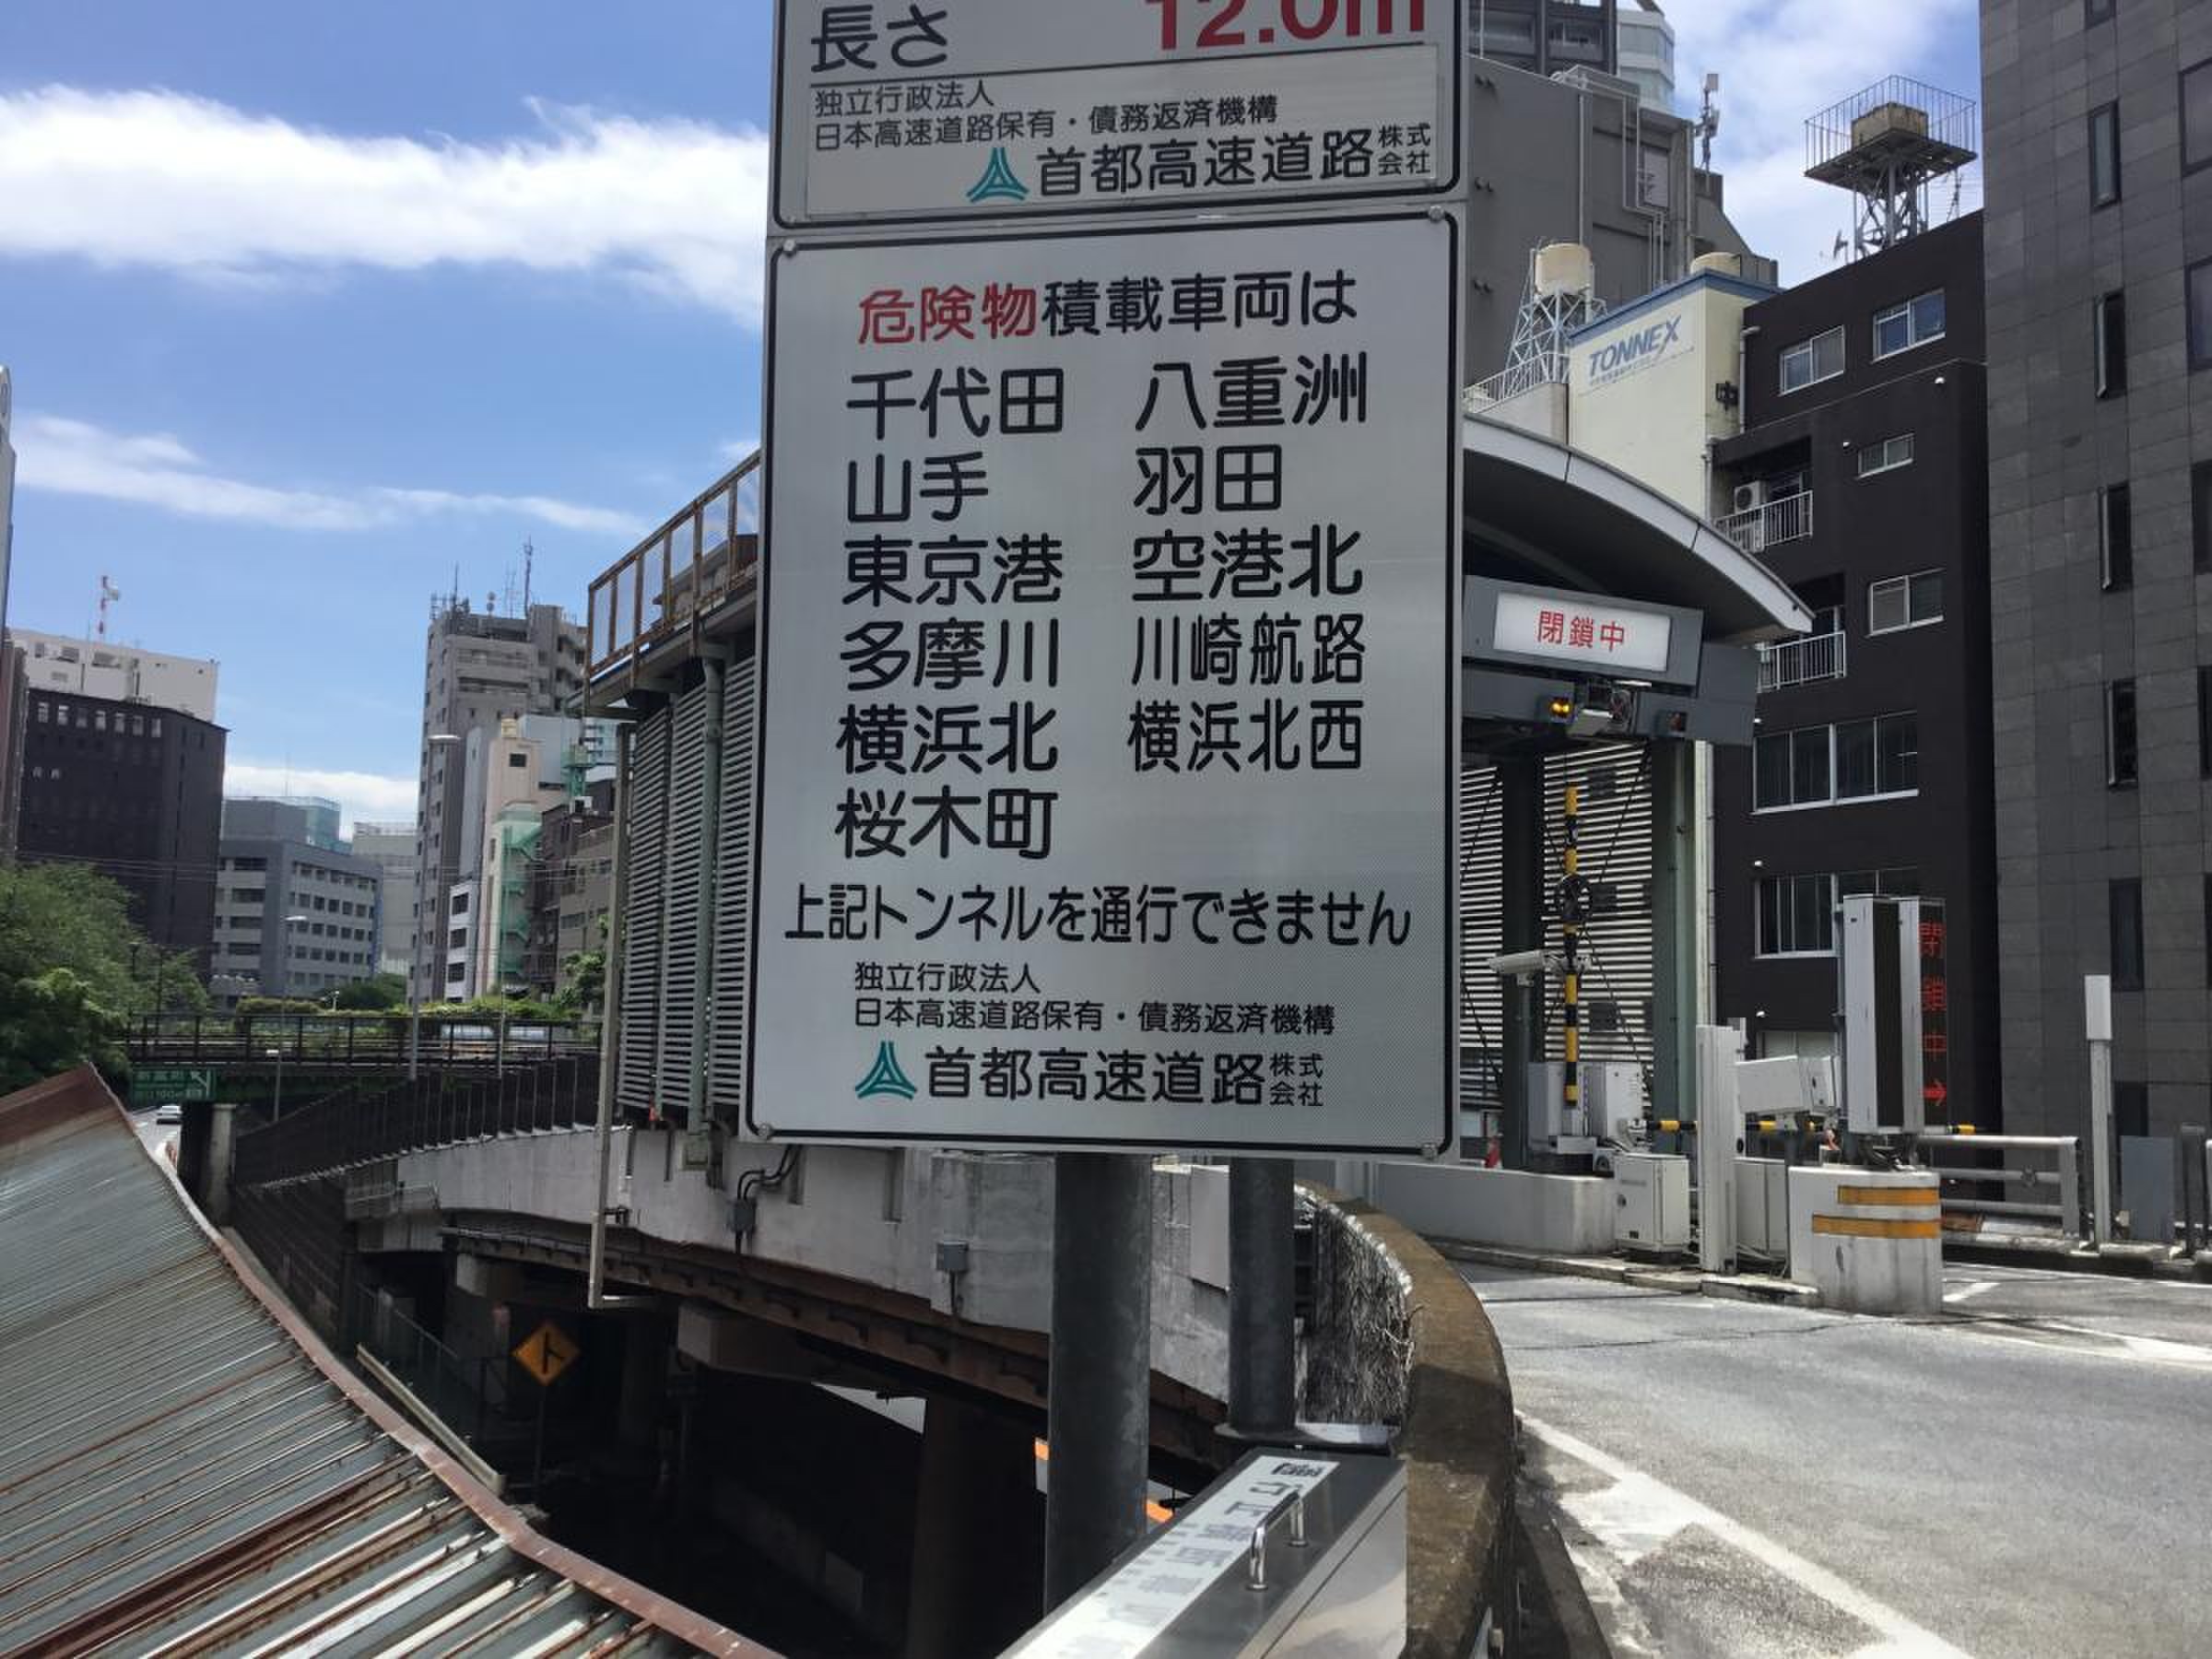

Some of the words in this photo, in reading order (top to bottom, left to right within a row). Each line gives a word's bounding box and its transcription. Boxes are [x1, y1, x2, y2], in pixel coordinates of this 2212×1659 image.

[810, 4, 948, 74] 長さ
[814, 79, 994, 116] 独立行政法人
[1035, 128, 1374, 196] 首都高速道路
[1377, 122, 1431, 148] 株式
[1378, 149, 1430, 176] 会社
[857, 267, 1358, 345] 危険物積載車両は
[1589, 314, 1681, 376] TONNEX
[845, 365, 1065, 441] 千代田
[1135, 350, 1368, 432] 八重洲
[847, 450, 989, 524] 山手
[1133, 442, 1283, 517] 羽田
[841, 532, 1065, 608] 東京港
[1131, 522, 1364, 603] 空港北
[840, 616, 1060, 692] 多摩川
[1131, 611, 1367, 687] 川崎航路
[1537, 611, 1624, 652] 閉鎖中
[834, 700, 1059, 775] 横浜北
[1126, 697, 1365, 774] 横浜北西
[833, 783, 1060, 861] 桜木町
[783, 882, 1411, 947] 上記トンネルを通行できません
[854, 960, 1041, 994] 独立行政法人
[924, 1044, 1266, 1106] 首都高速道路
[1269, 1052, 1328, 1079] 株式
[1269, 1080, 1324, 1107] 会社
